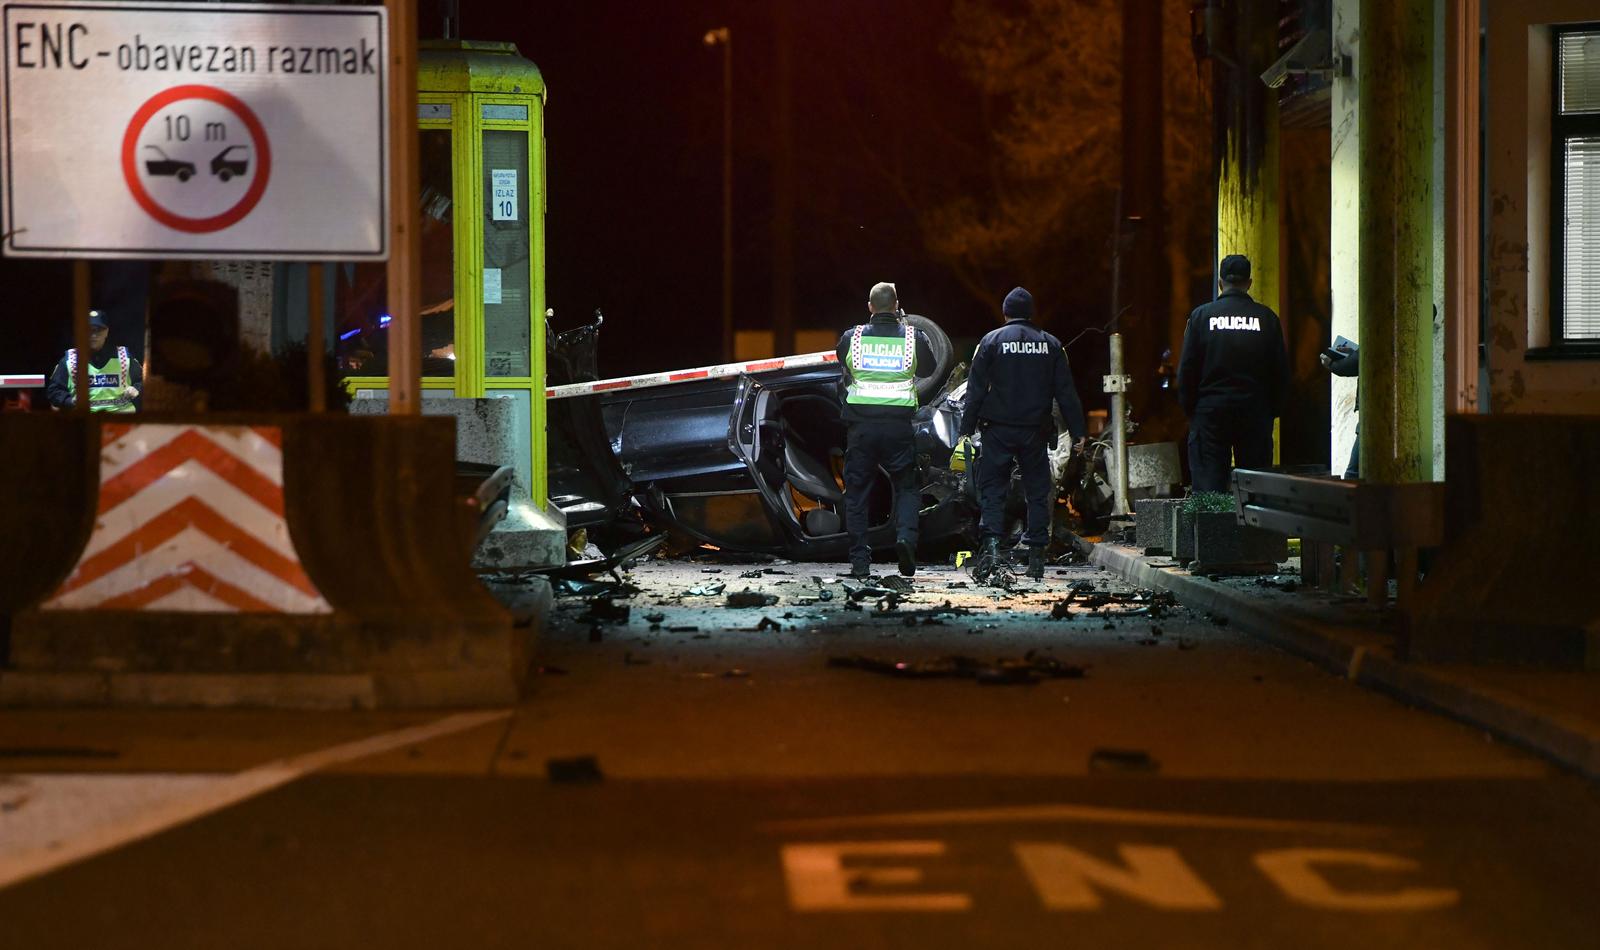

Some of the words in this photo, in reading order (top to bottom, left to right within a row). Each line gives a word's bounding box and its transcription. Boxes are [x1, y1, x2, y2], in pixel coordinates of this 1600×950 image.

[268, 38, 375, 75] razmak
[164, 114, 190, 141] 10
[205, 121, 226, 141] m
[495, 189, 515, 198] IZLAZ
[499, 200, 512, 217] 10
[1209, 316, 1260, 331] POLICIJA
[1002, 341, 1049, 354] POLICIJA
[863, 357, 902, 368] POLICIJA
[781, 840, 1461, 911] ENC
